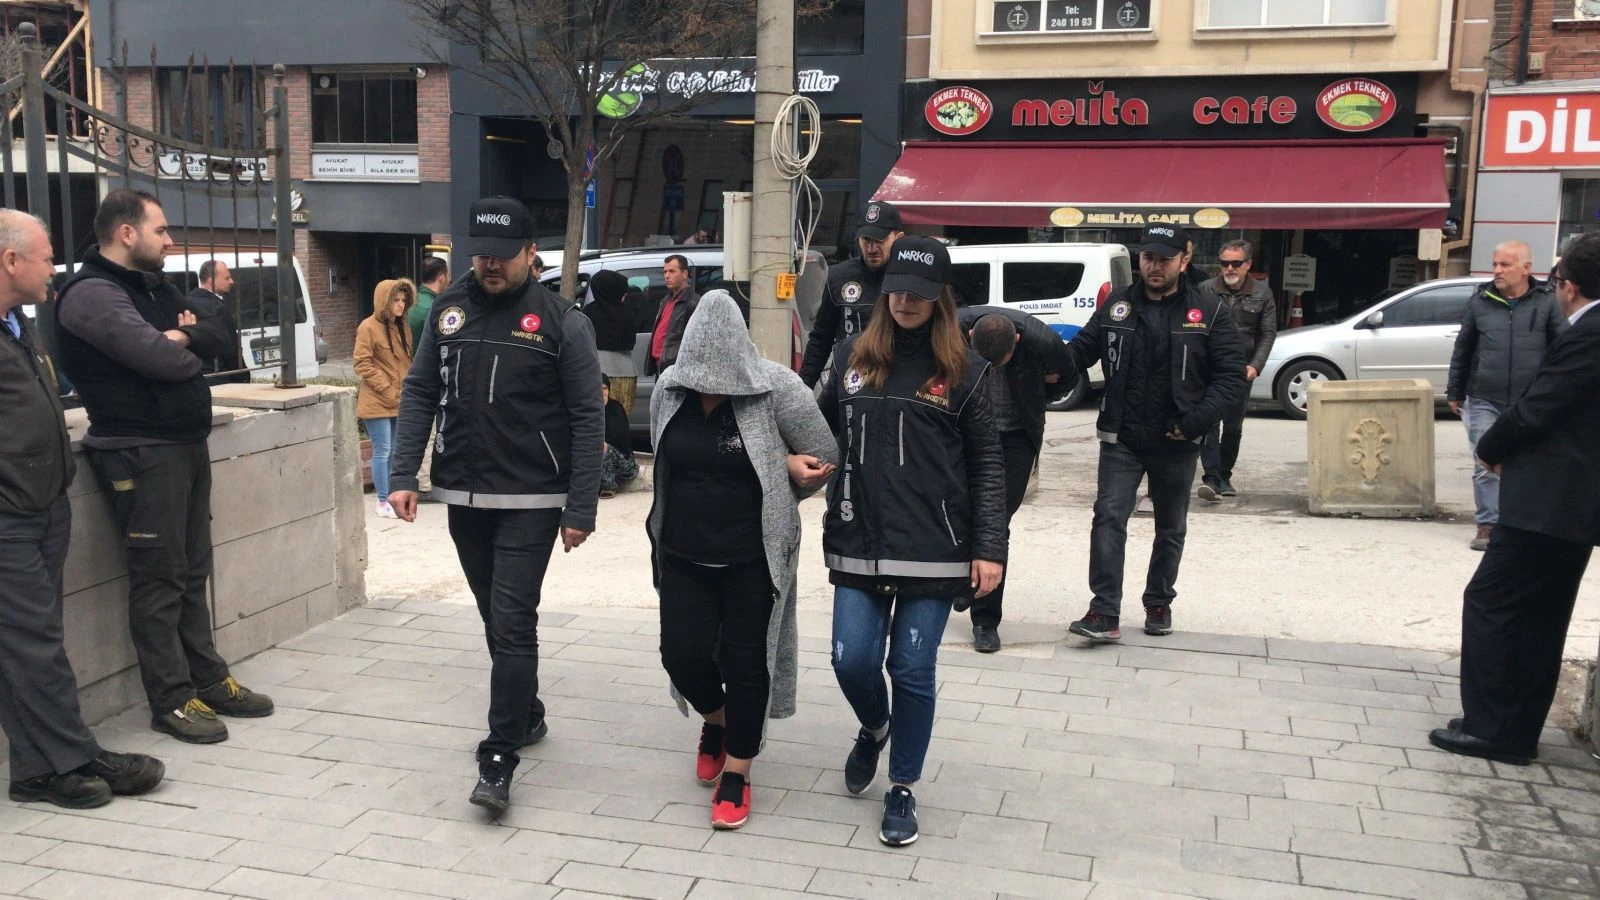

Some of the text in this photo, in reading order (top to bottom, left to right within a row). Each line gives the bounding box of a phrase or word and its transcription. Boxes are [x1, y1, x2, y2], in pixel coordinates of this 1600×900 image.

[1065, 6, 1080, 15] Tel:
[1051, 18, 1092, 27] 240 19 93
[933, 87, 989, 114] EKMEK TEKNESİ
[1322, 81, 1390, 106] EKMEK TEKNESİ
[1192, 96, 1297, 125] cafe
[1504, 98, 1600, 154] DİL
[1087, 211, 1145, 224] MELİTA
[1148, 213, 1190, 225] CAFE
[1073, 298, 1095, 308] 155
